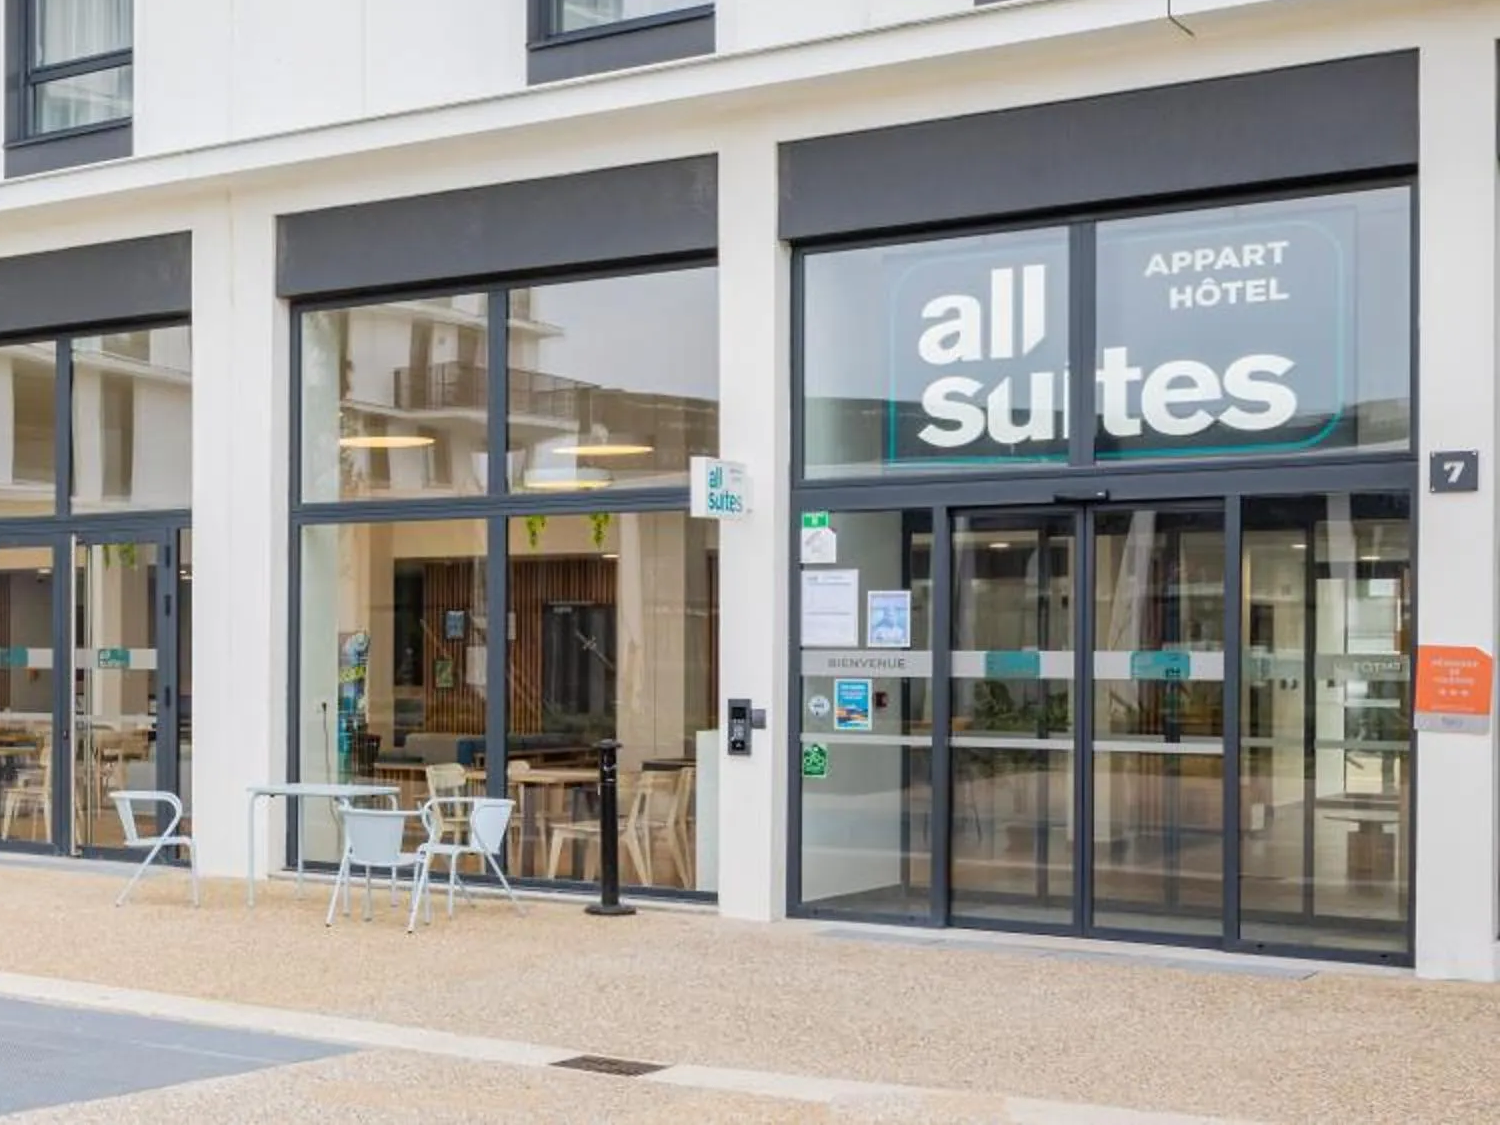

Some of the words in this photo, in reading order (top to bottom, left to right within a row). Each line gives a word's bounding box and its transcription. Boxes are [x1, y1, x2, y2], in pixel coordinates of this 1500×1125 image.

[1144, 240, 1290, 275] APPART
[1169, 278, 1290, 310] HÔTEL
[918, 264, 1046, 365] all
[917, 346, 1298, 448] sutes
[708, 466, 723, 489] all
[1443, 460, 1465, 483] 7
[827, 658, 906, 669] BIENVENUE
